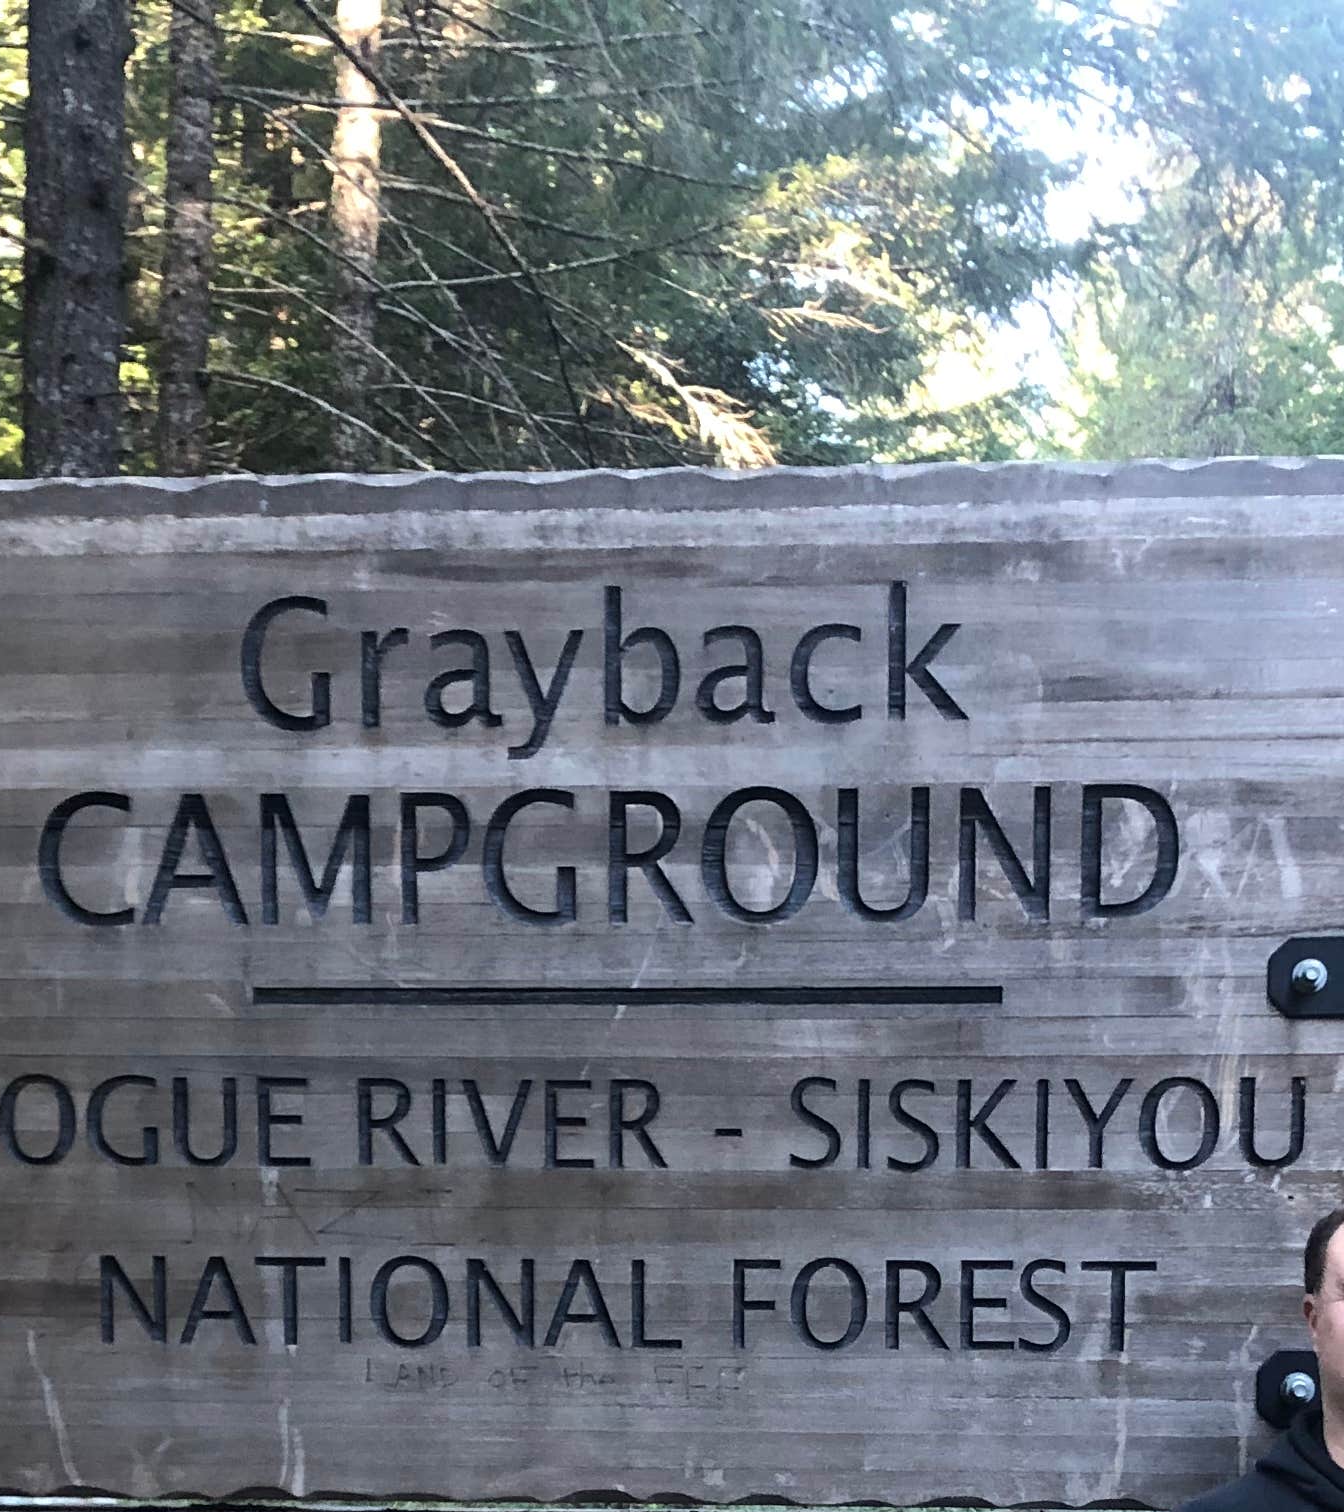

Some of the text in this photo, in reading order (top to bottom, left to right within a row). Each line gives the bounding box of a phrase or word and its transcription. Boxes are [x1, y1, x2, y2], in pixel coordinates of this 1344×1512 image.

[240, 580, 969, 759] Grayback
[37, 784, 1180, 929] CAMPGROUND
[358, 1077, 668, 1170] RIVER
[789, 1076, 1307, 1174] SISKIYOU
[99, 1255, 1157, 1353] NATIONAL FOREST
